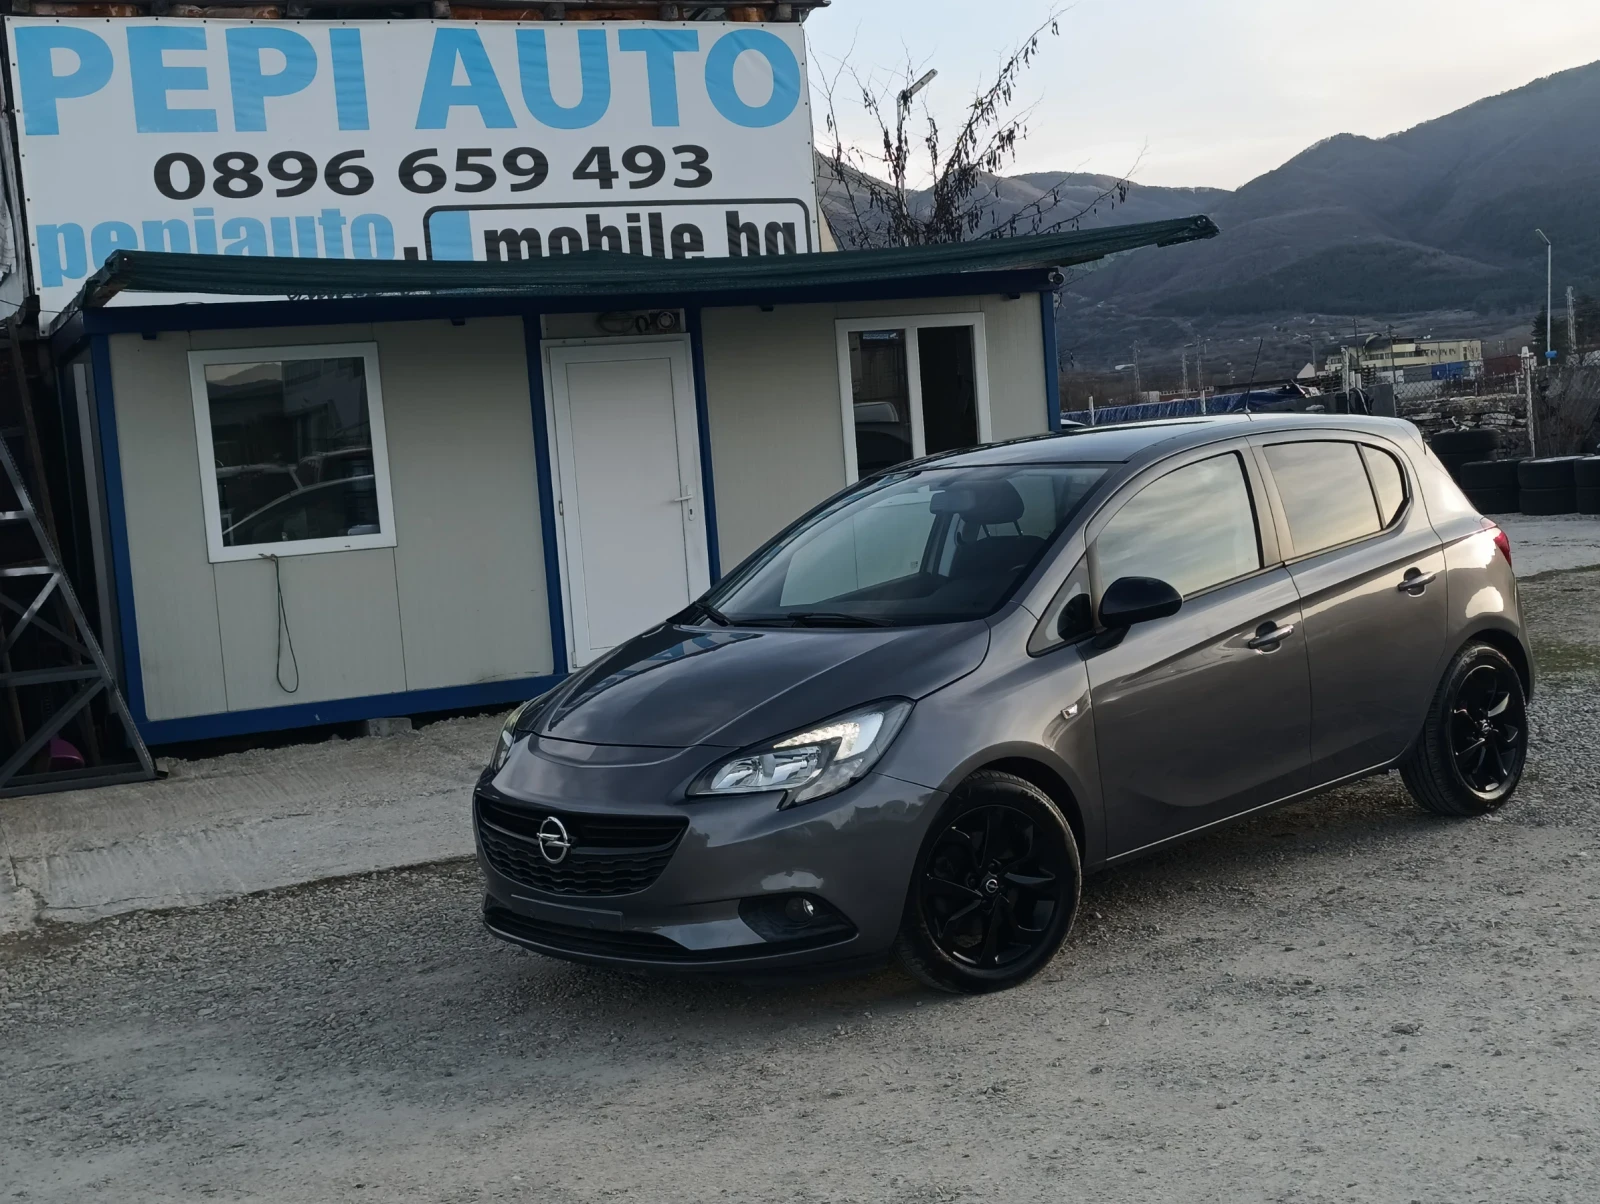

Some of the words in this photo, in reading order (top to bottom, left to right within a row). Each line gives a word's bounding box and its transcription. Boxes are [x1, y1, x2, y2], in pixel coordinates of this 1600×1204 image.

[14, 25, 370, 135] PEPI
[415, 27, 800, 130] AUTO
[153, 149, 374, 200] 0896
[399, 146, 549, 194] 659
[572, 144, 713, 190] 493
